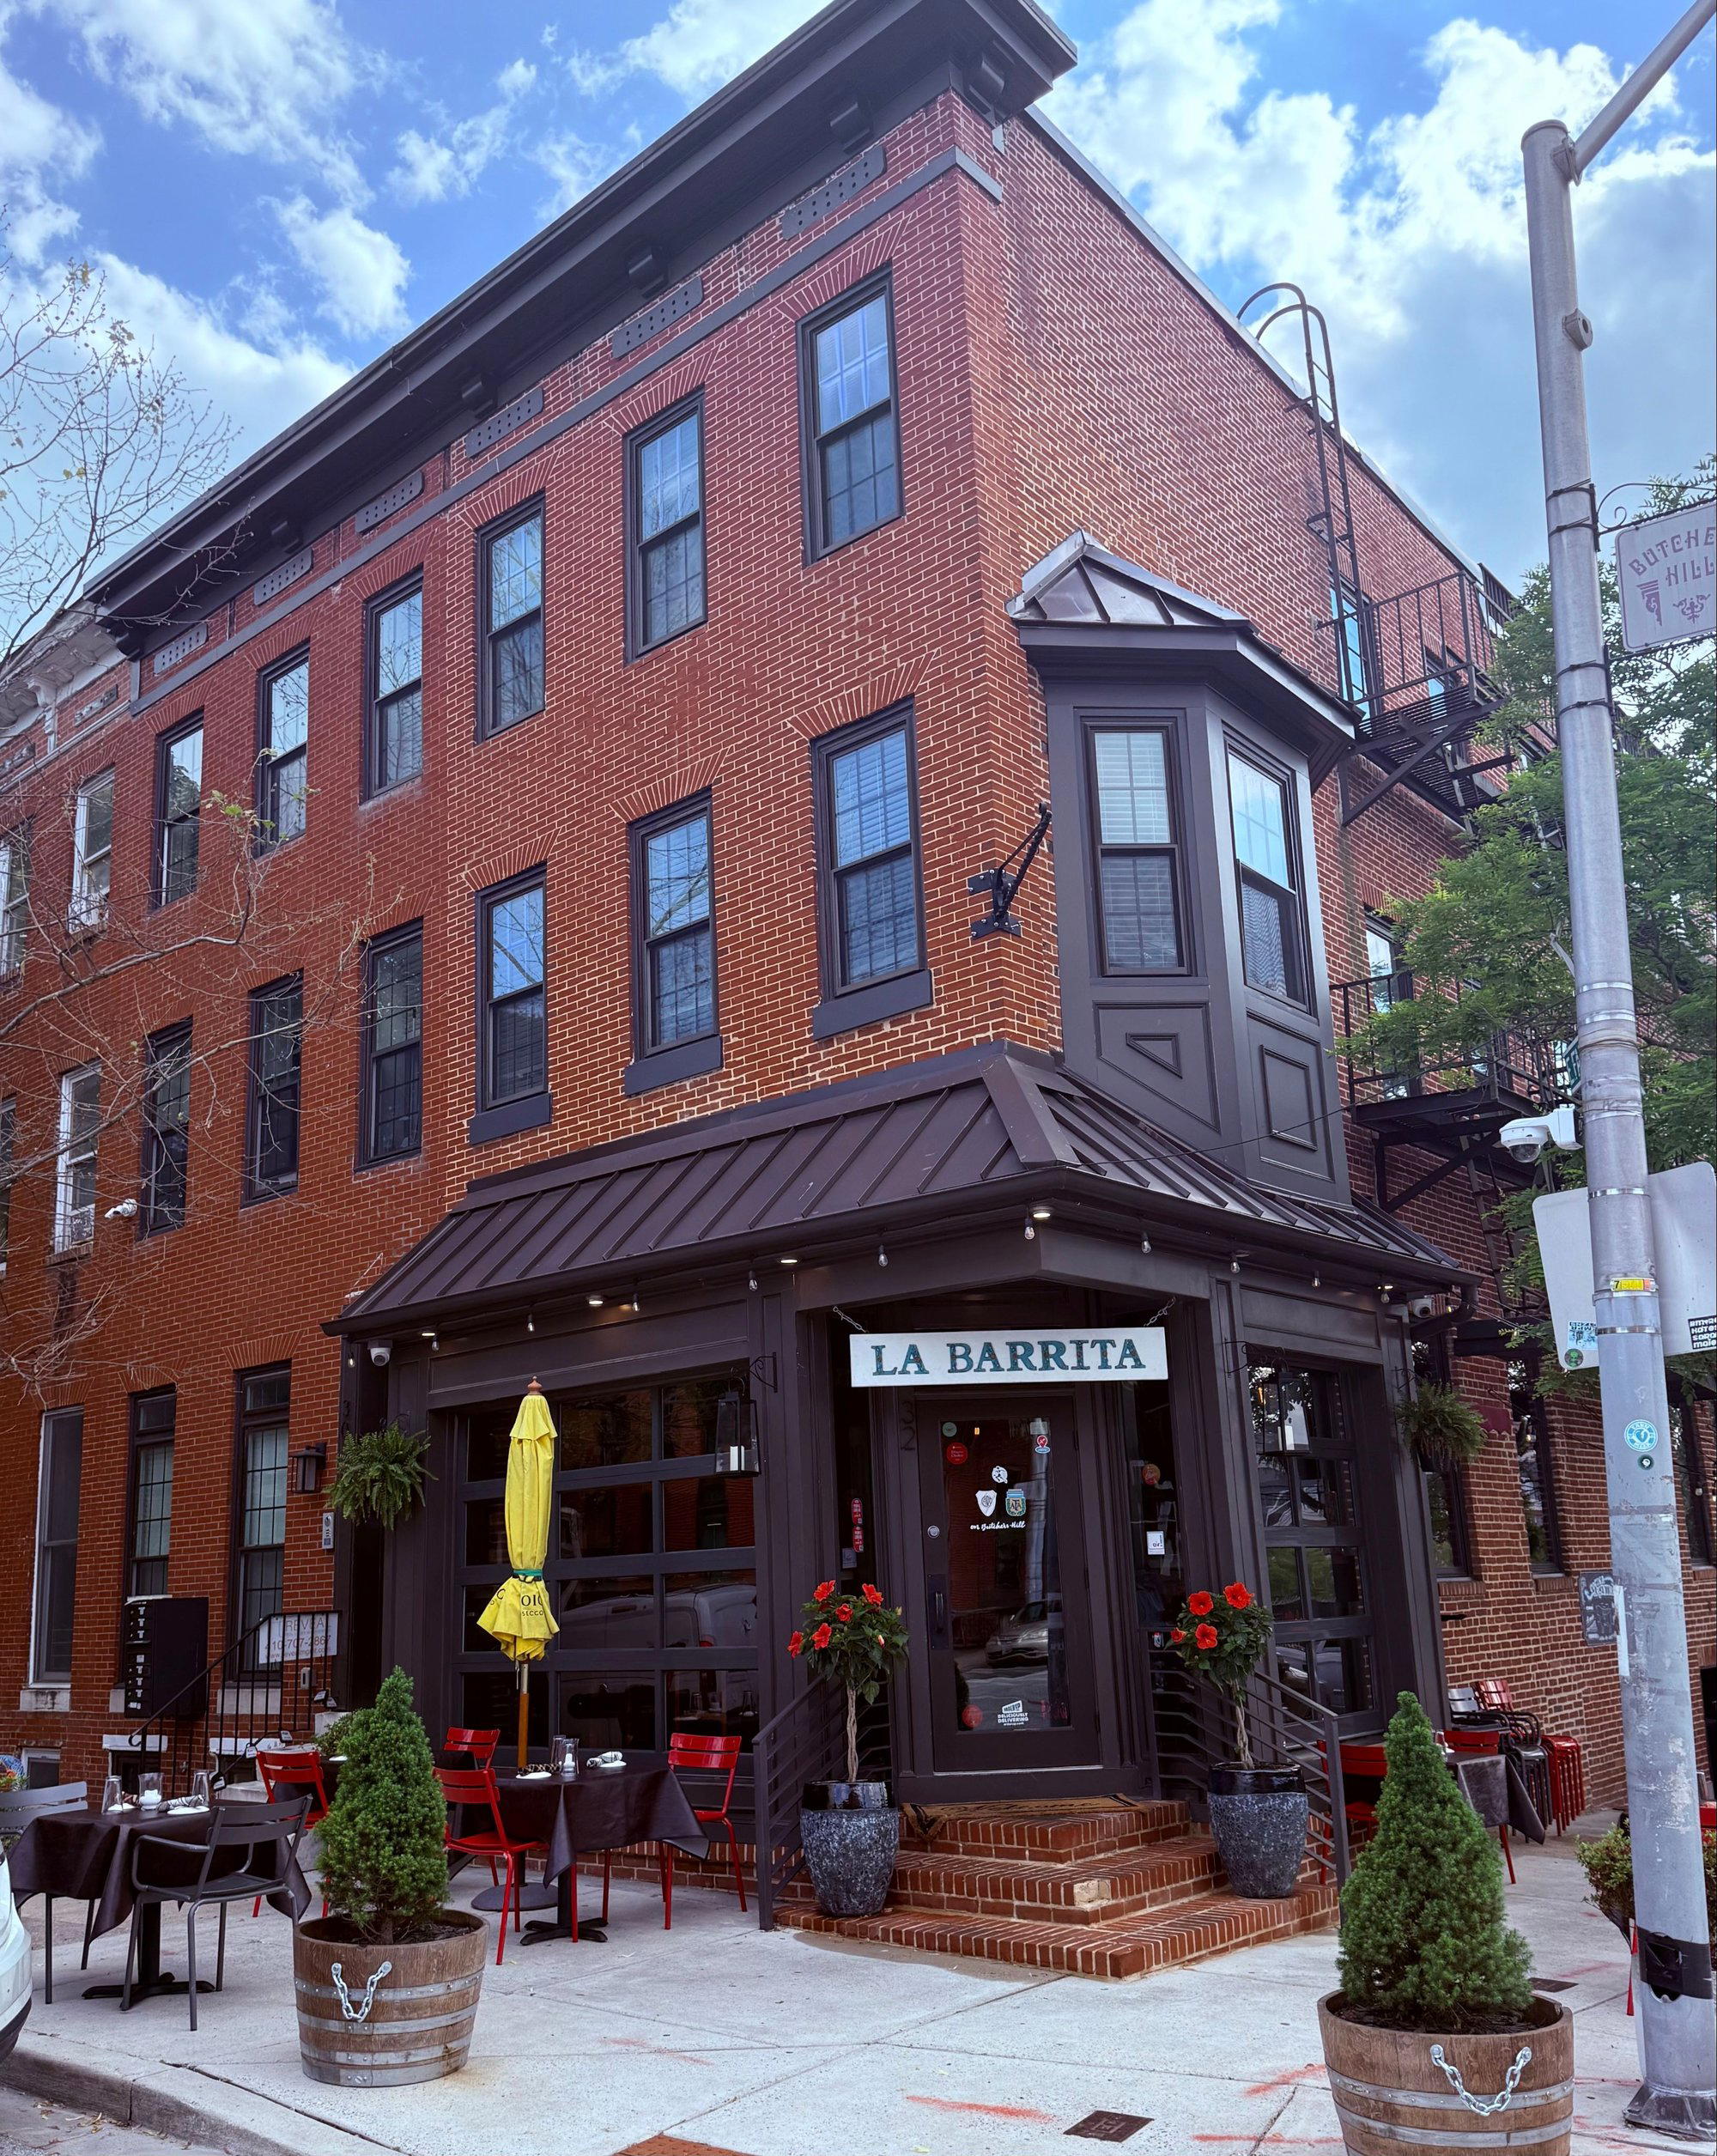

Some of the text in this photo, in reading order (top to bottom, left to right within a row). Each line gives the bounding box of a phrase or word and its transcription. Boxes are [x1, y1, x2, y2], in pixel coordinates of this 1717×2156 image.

[1665, 556, 1715, 587] HILL
[871, 1338, 1147, 1377] LA BARRITA
